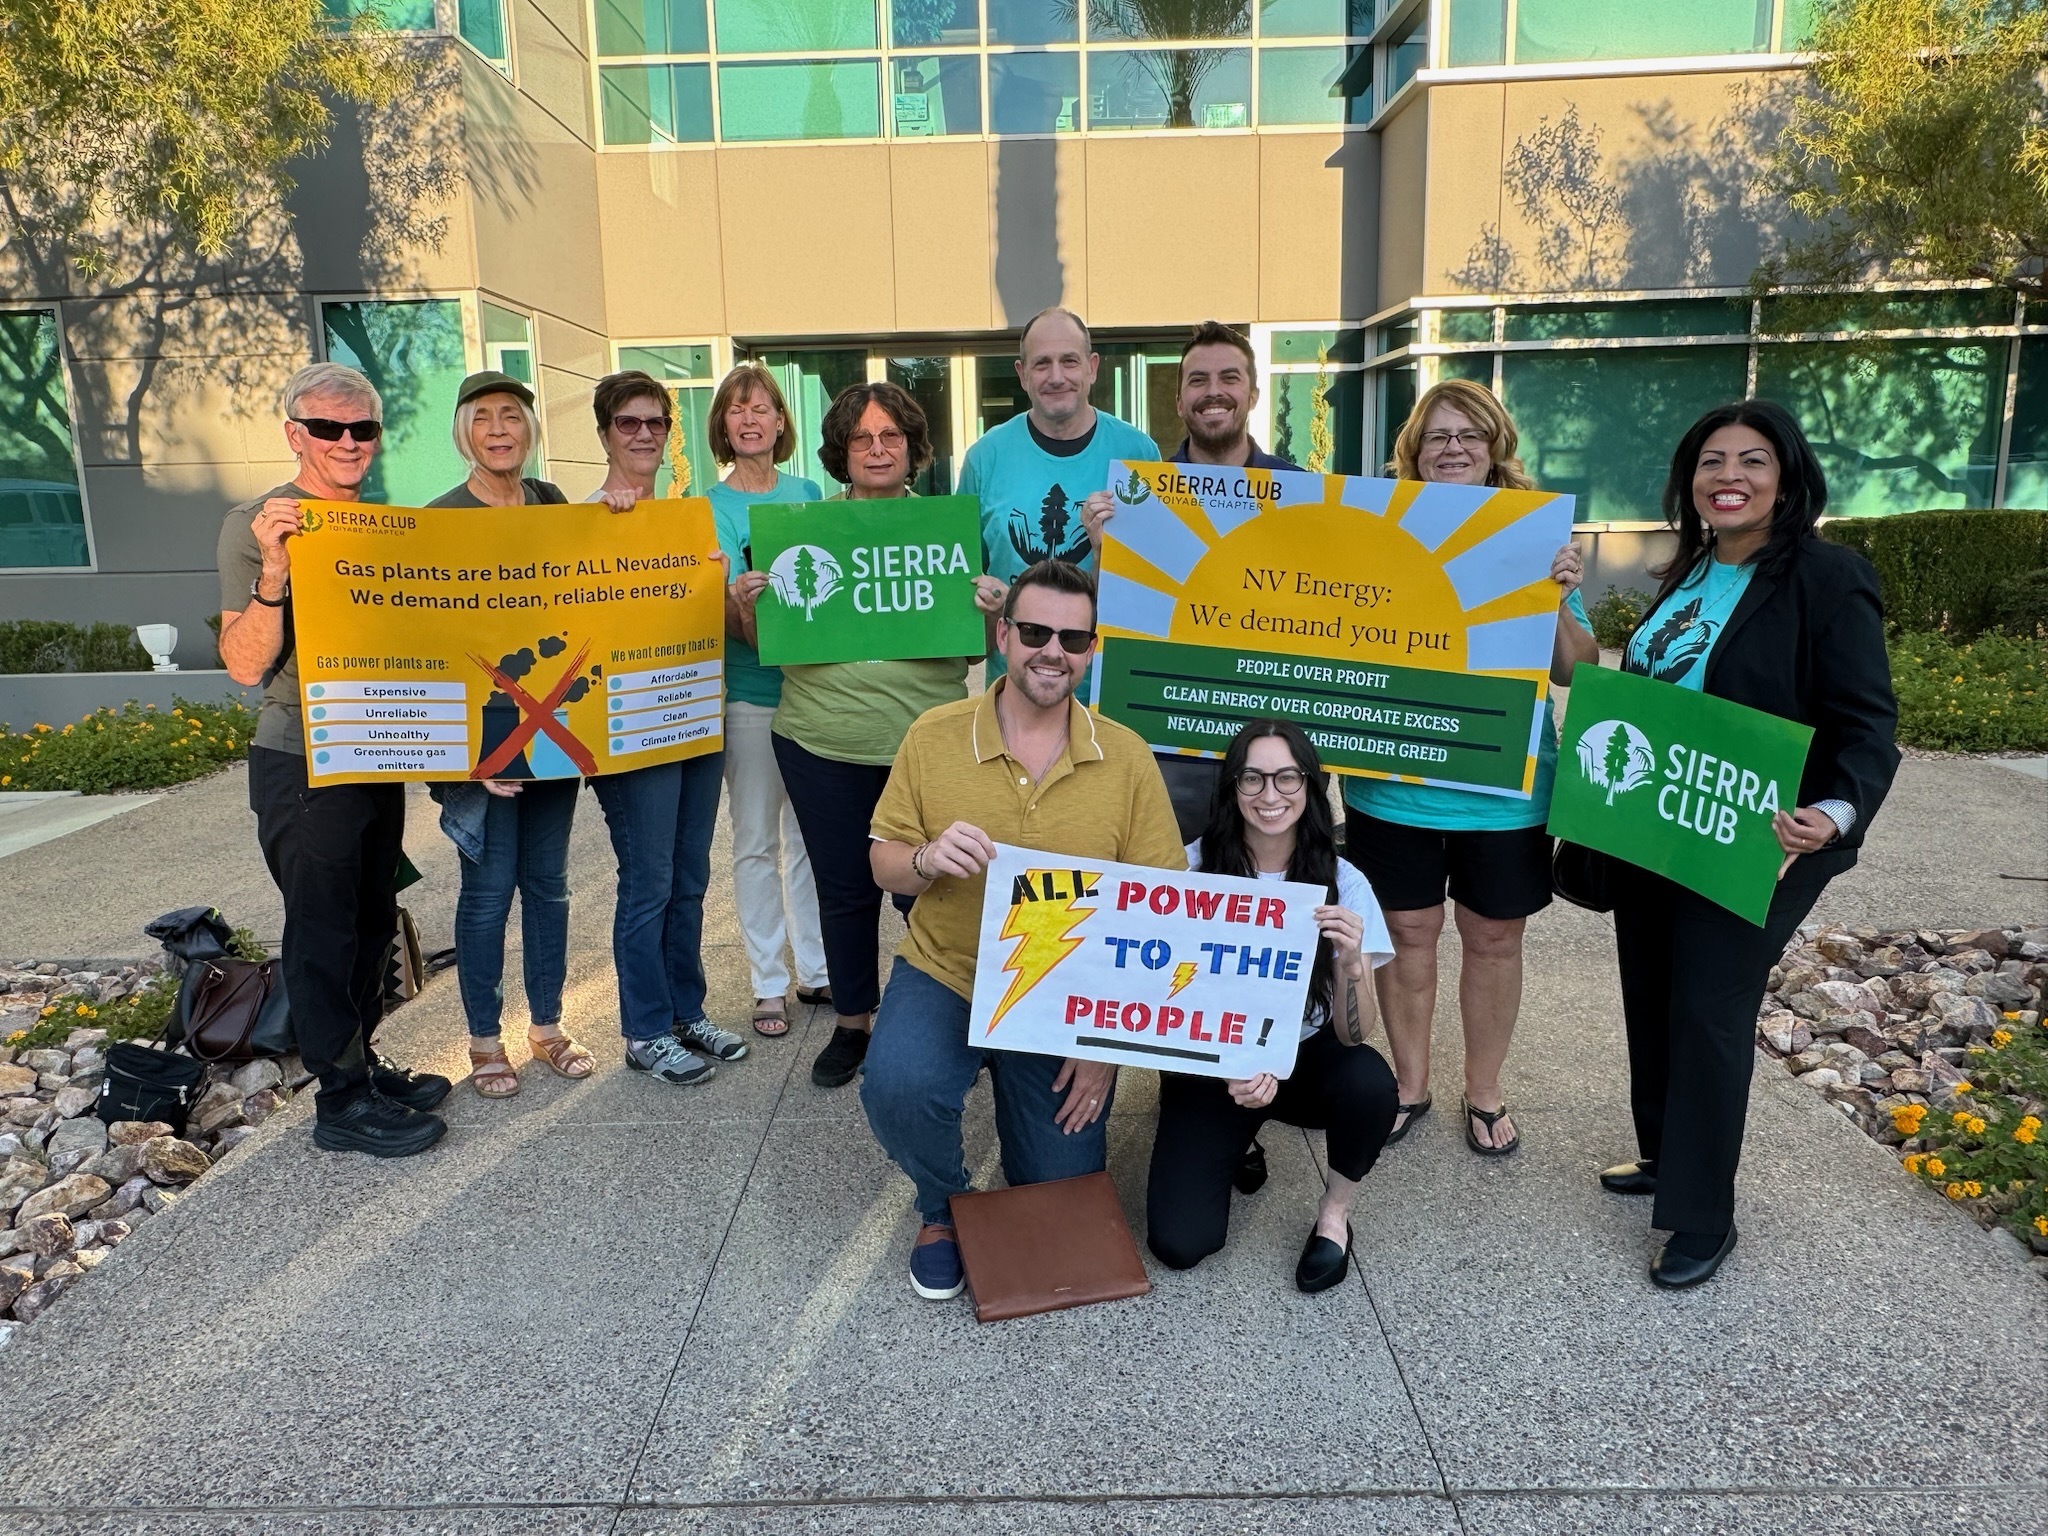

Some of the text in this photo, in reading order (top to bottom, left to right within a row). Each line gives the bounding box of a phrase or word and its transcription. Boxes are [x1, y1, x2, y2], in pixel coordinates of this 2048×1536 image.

[1156, 473, 1283, 501] SIERRA CLUB
[1156, 495, 1264, 511] TOIYABE CHAPTER
[327, 510, 417, 529] SIERRA CLUB
[366, 528, 405, 536] CHAPTER
[335, 553, 701, 582] Gas plants are bad for ALL Nevadans.
[851, 543, 971, 580] SIERRA
[349, 582, 693, 610] We demand clean, reliable energy.
[853, 580, 936, 614] CLUB
[1242, 567, 1392, 608] NV Energy:
[1189, 603, 1451, 654] We demand you put
[317, 655, 449, 670] Gas power plants are:
[611, 637, 718, 662] We want energy that is:
[650, 669, 698, 685] Affordable
[1236, 658, 1390, 689] PEOPLE OVER PROFIT
[364, 687, 427, 698] Expensive
[657, 690, 693, 704] Reliable
[365, 708, 428, 718] Unreliable
[662, 711, 688, 722] Clean
[1163, 685, 1460, 733] CLEAN ENERGY OVER CORPORATE EXCESS
[368, 730, 430, 741] Unhealthy
[641, 726, 710, 747] Climate friendly
[1167, 715, 1448, 762] NEVADANS AREHOLDER GREED
[354, 747, 446, 759] Greenhouse gas
[377, 761, 425, 770] emitters
[1663, 743, 1780, 815] SIERRA
[1657, 783, 1739, 845] CLUB
[1010, 869, 1287, 929] ALL POWER
[1104, 936, 1303, 981] TO THE
